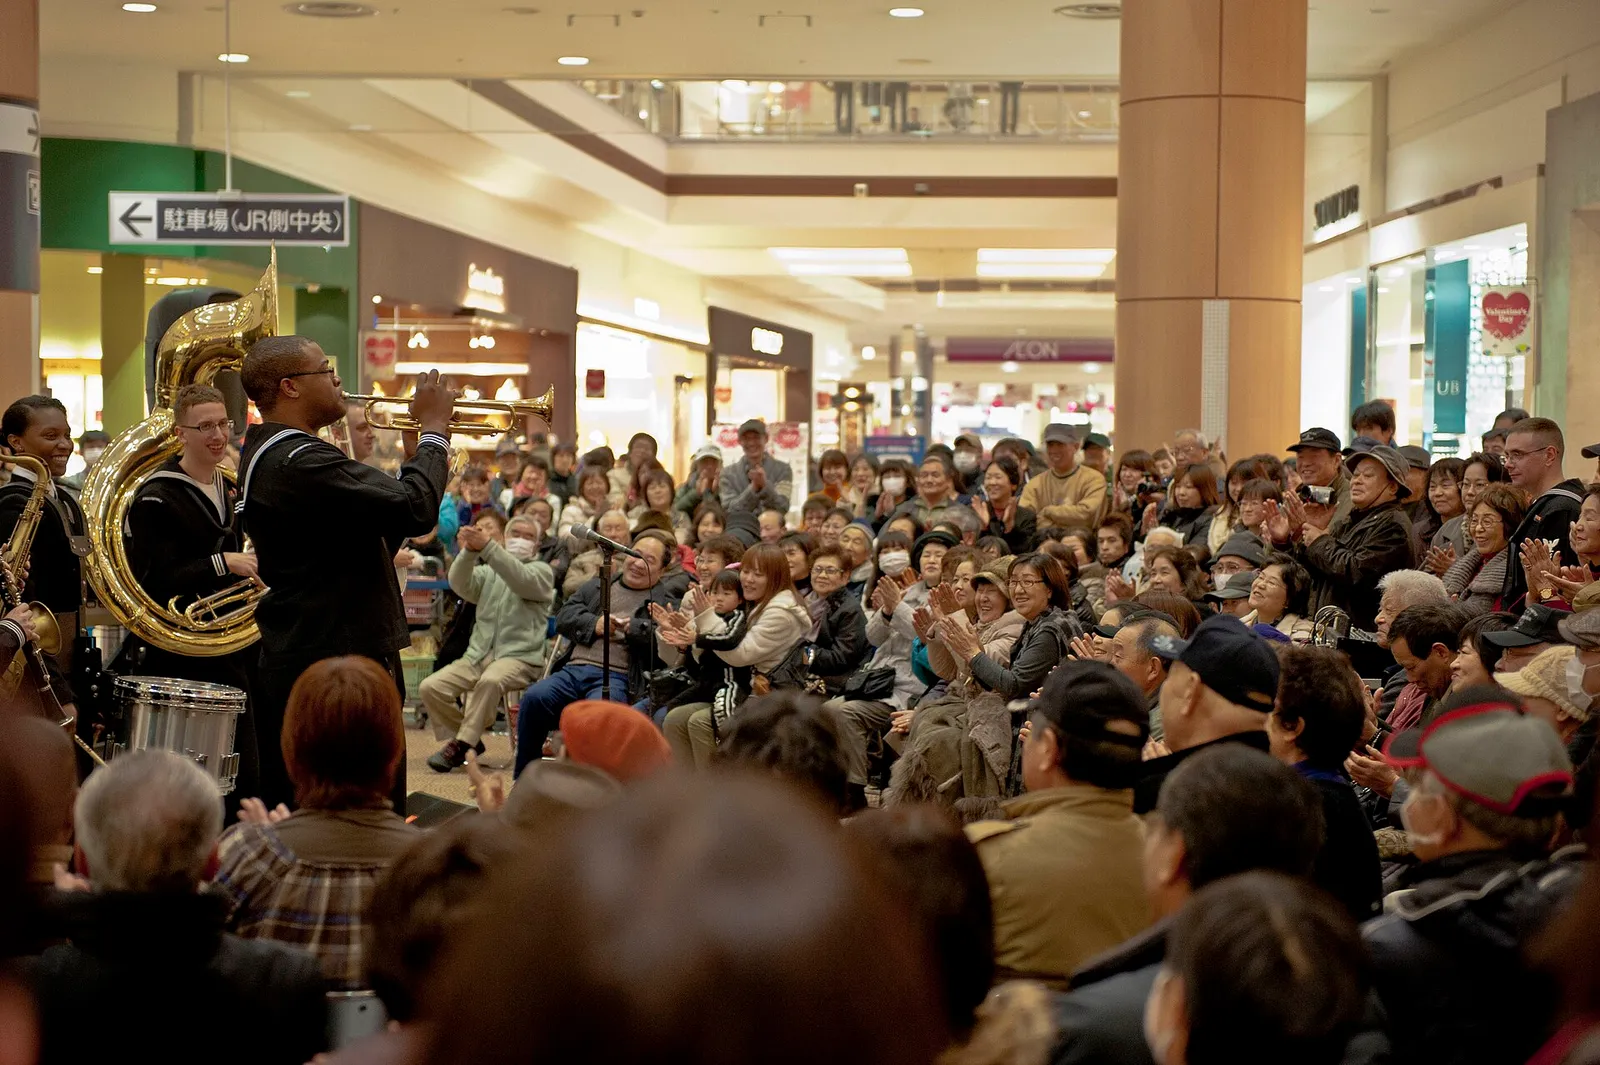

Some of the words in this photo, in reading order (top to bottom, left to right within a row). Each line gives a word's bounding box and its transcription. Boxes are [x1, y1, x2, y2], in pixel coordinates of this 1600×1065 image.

[163, 207, 342, 233] 駐車場(JR側中央)
[1498, 315, 1513, 324] Day
